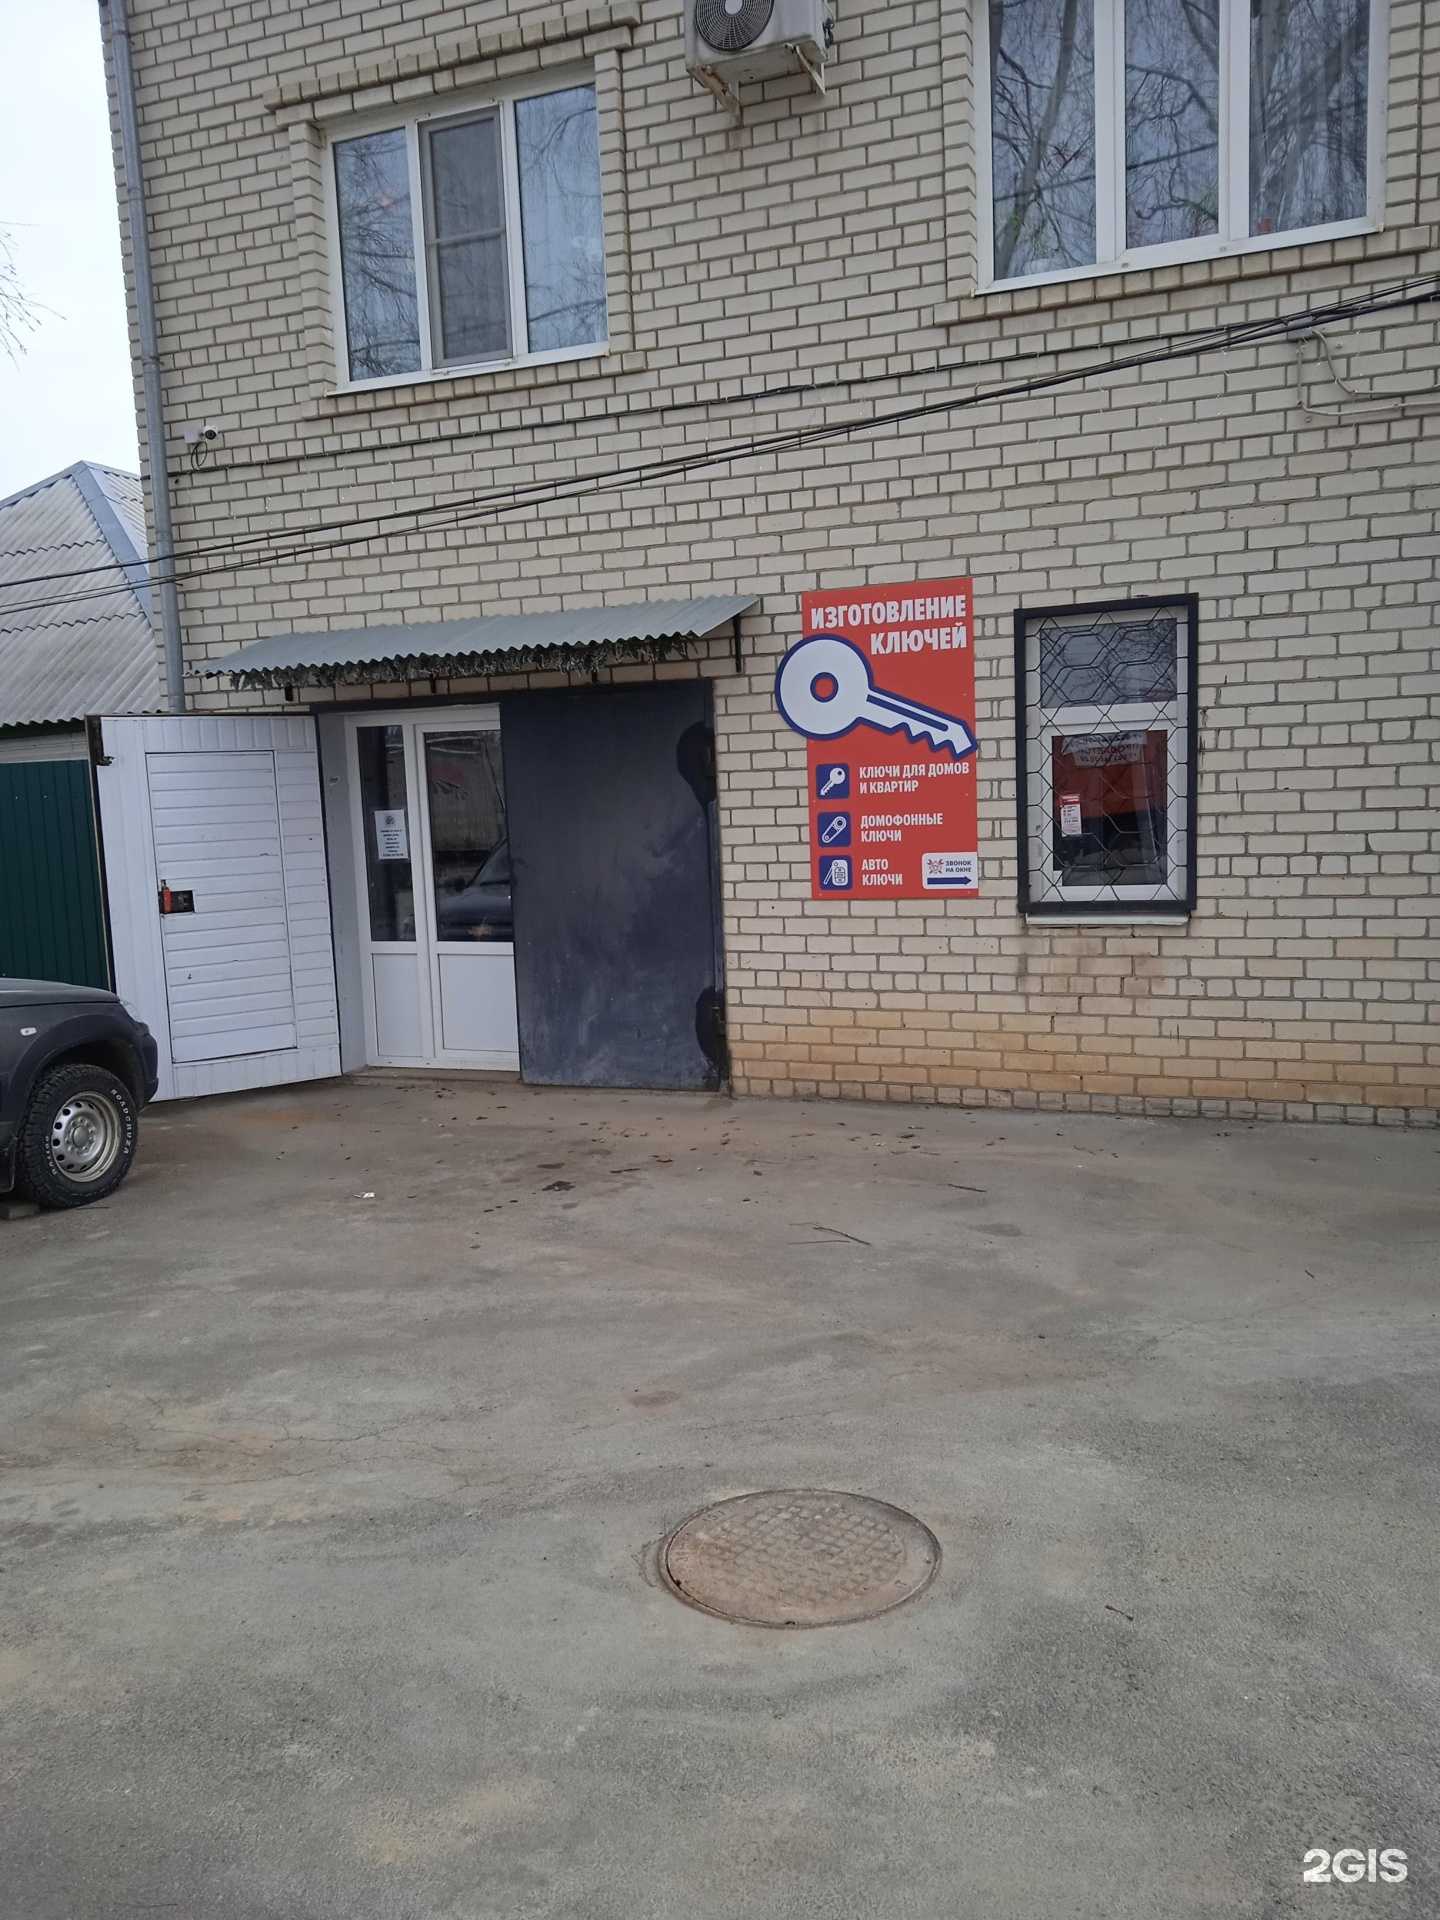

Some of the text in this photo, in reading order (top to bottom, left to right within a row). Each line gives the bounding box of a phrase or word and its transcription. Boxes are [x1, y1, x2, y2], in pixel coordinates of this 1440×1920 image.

[811, 595, 967, 629] ИЗГОТОВЛЕНИЕ
[871, 622, 967, 655] КЛЮЧЕЙ
[860, 762, 969, 779] КЛЮЧИ ДЛЯ ДОМОВ
[860, 780, 919, 794] И КВАРТИР
[861, 813, 943, 829] ДОМОФОННЫЕ
[861, 830, 902, 843] КЛЮЧИ
[862, 858, 889, 871] АВТО
[862, 873, 903, 886] КЛЮЧИ
